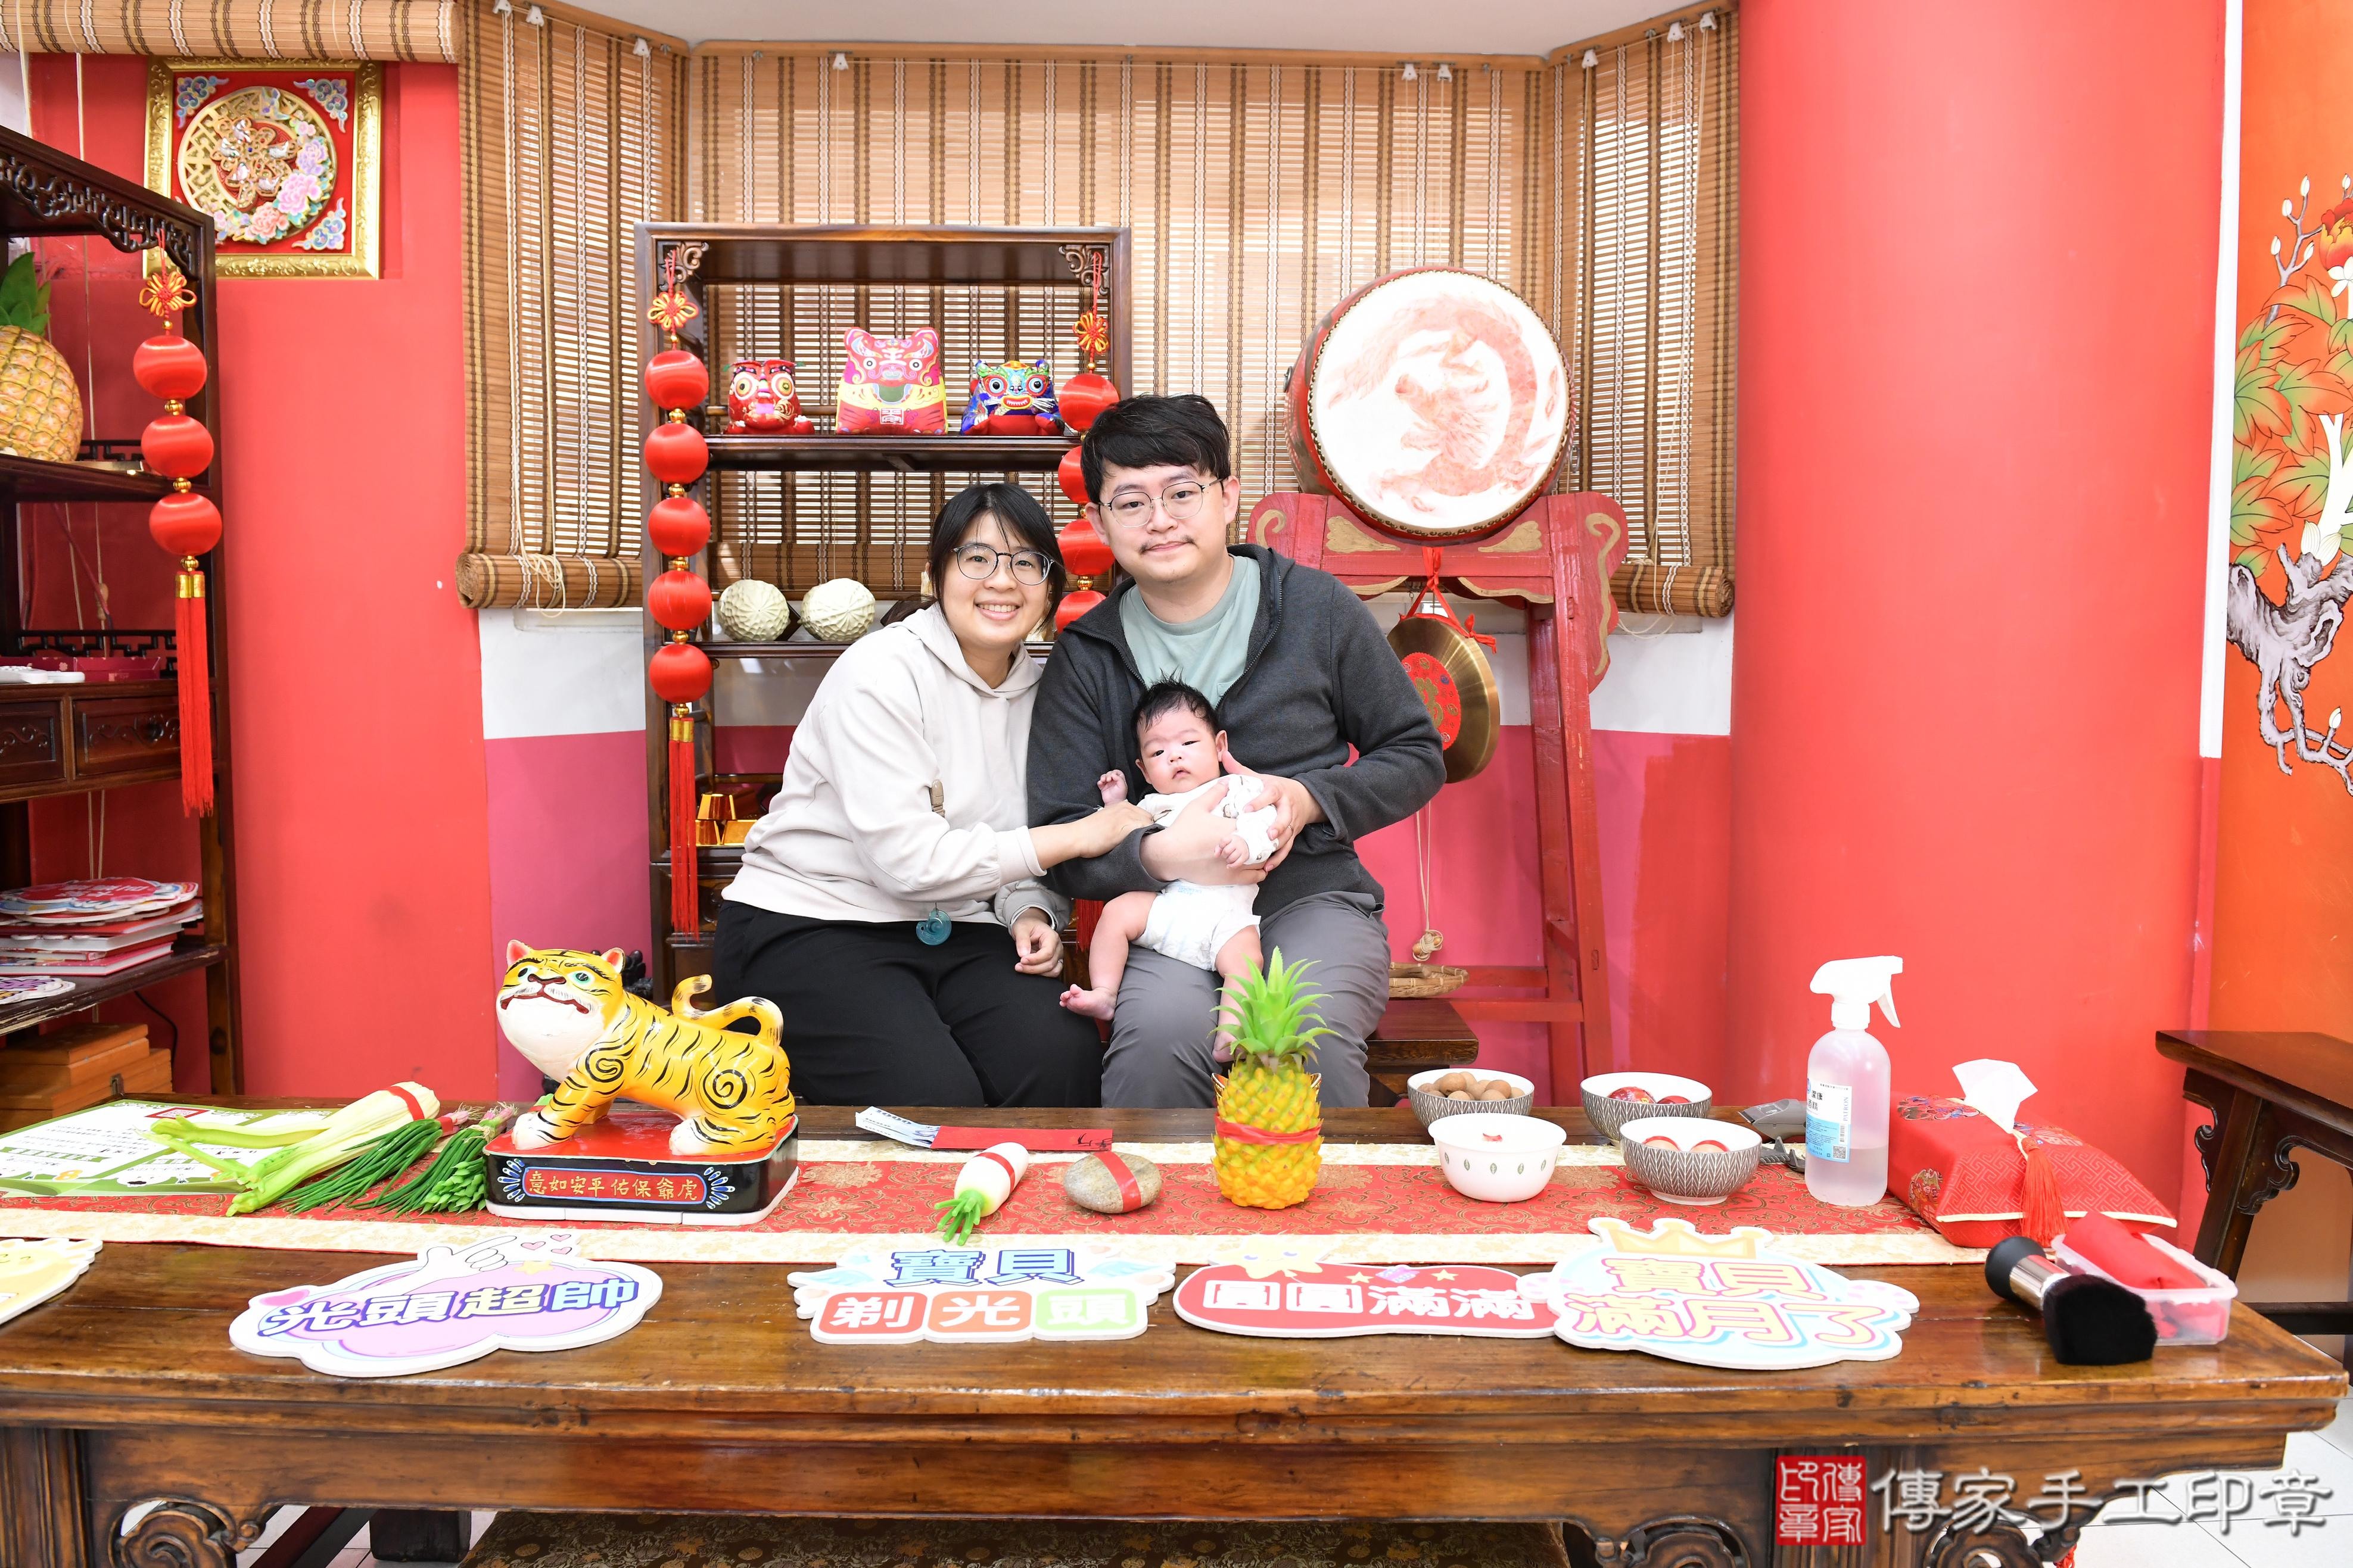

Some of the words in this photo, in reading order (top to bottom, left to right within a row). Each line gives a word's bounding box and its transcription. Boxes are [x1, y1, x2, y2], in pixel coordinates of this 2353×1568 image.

[883, 1248, 1085, 1288] 寶貝
[1601, 1258, 1827, 1301] 寶貝
[257, 1279, 639, 1336] 光頭超帥
[833, 1294, 1130, 1328] 剃光頭
[1203, 1279, 1535, 1320] 圓圓滿滿
[1564, 1293, 1885, 1344] 滿月了
